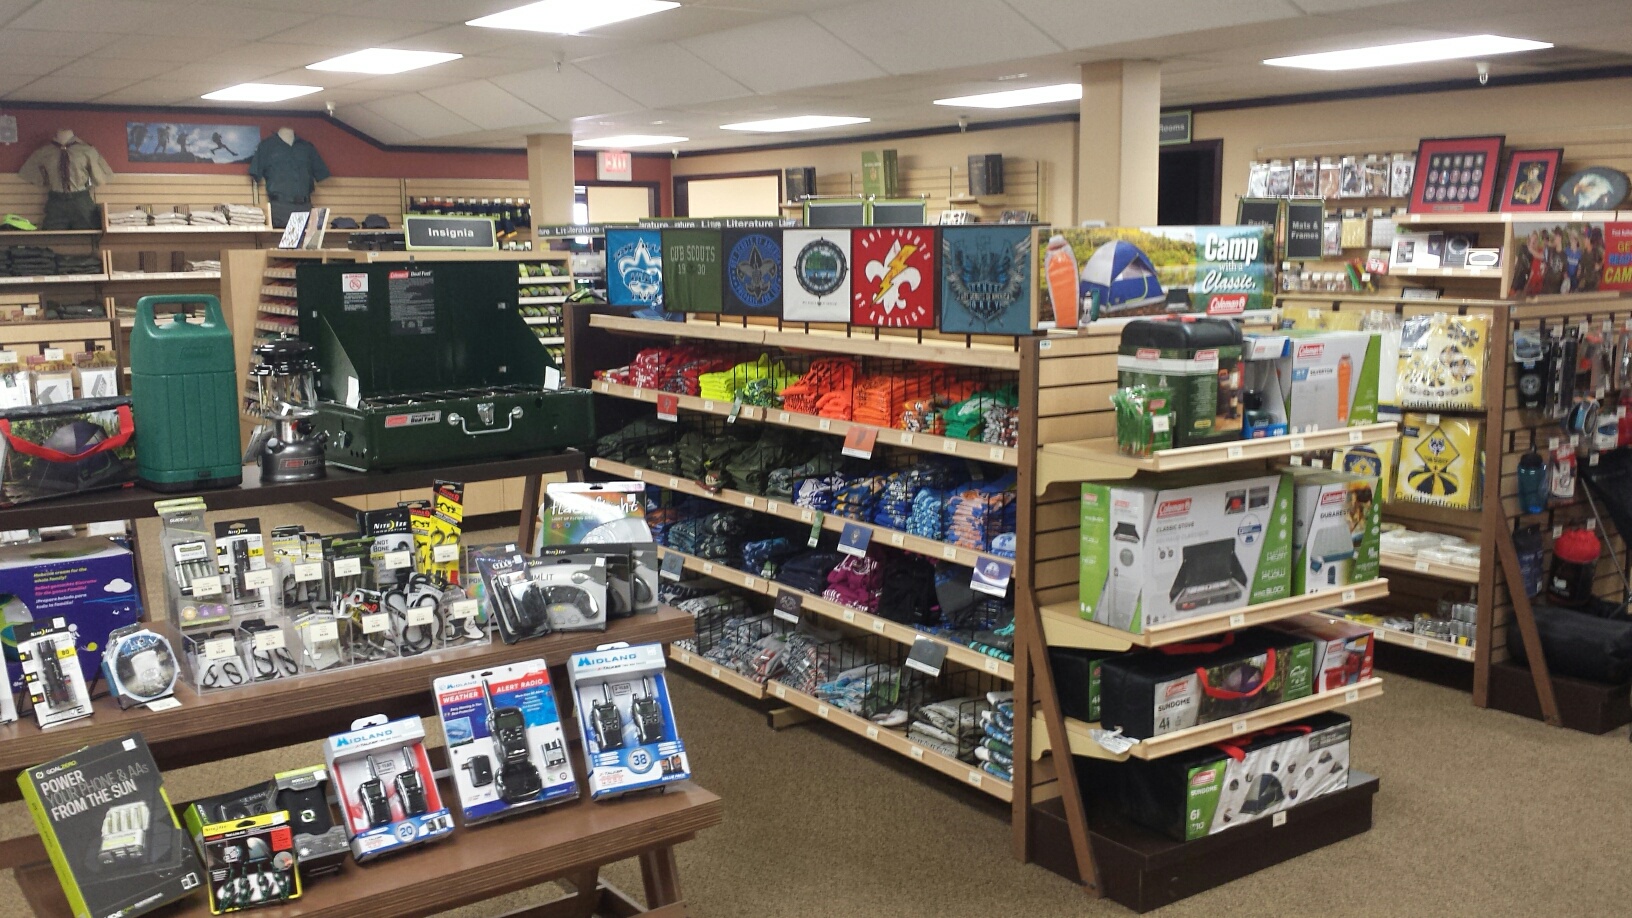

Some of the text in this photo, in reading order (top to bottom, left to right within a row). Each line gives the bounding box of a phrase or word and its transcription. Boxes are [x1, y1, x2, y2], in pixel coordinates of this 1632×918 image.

[605, 153, 628, 171] EXIT
[726, 219, 774, 228] Literature
[1292, 220, 1319, 230] Mats &
[428, 227, 474, 239] Insignia
[1291, 231, 1319, 240] Frames
[861, 229, 883, 249] BOY
[891, 228, 932, 261] SCOUTS
[1204, 232, 1259, 266] Camp
[670, 246, 685, 262] CUB
[686, 245, 716, 263] SCOUTS
[678, 264, 687, 276] 19
[1219, 262, 1244, 272] with a
[1604, 266, 1632, 285] CAM
[855, 291, 866, 308] OF
[1210, 297, 1240, 312] Coleman
[869, 305, 927, 327] AMERICA
[1401, 399, 1474, 410] Celebrations
[410, 416, 423, 424] Dual
[424, 414, 436, 422] Fuel
[1158, 501, 1183, 517] Coleman
[1395, 491, 1468, 511] Celebrations
[578, 653, 637, 667] MIDLAND
[442, 691, 479, 704] WEATHER
[496, 684, 519, 694] ALERT
[520, 678, 544, 689] RADIO
[1158, 697, 1191, 712] SUNDOME
[336, 729, 393, 748] MIDLAND
[633, 754, 648, 766] 38
[40, 769, 86, 797] POWER
[46, 762, 150, 808] YOUR PHONE & AAs
[51, 778, 138, 822] FROM THE SUN
[399, 825, 414, 838] 20
